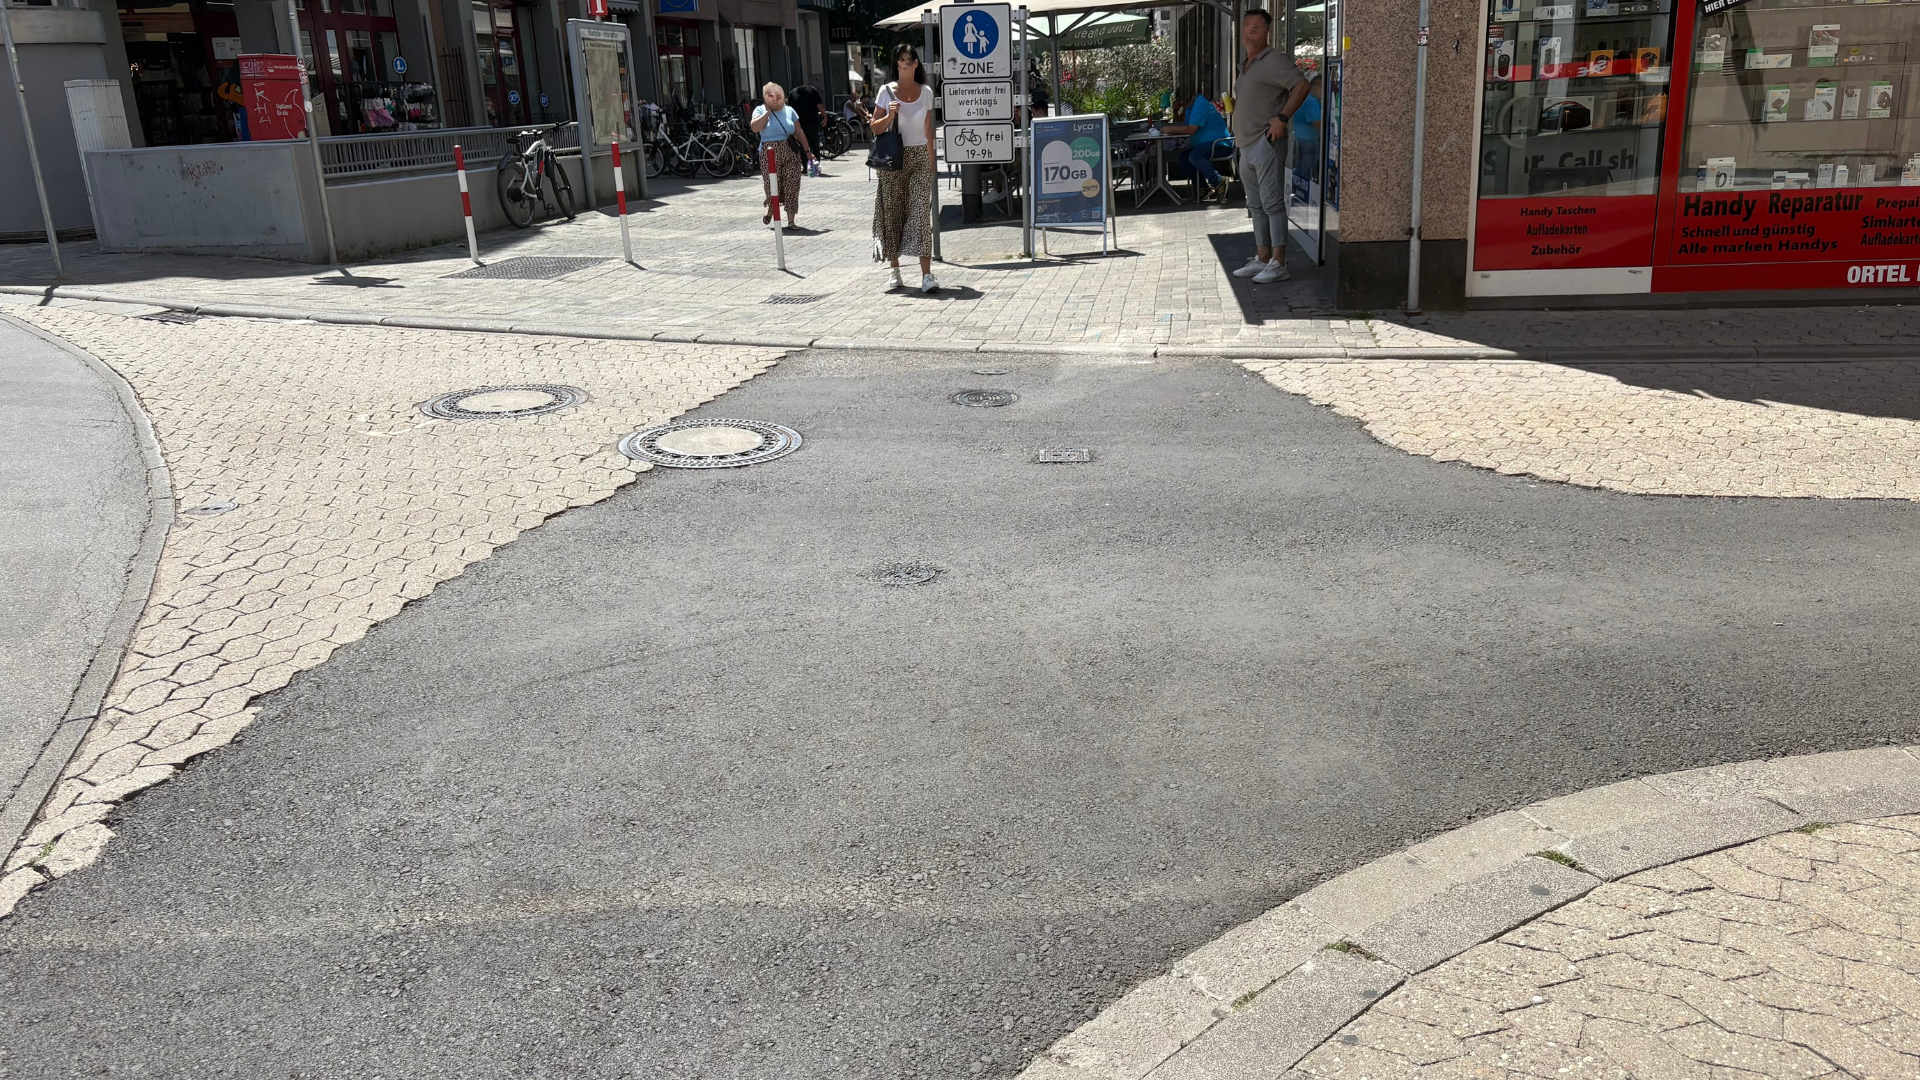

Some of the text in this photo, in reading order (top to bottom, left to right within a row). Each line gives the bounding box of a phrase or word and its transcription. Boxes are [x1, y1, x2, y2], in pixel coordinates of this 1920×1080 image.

[1704, 1, 1725, 13] HIER
[960, 61, 994, 74] ZONE
[949, 86, 1006, 96] Lieferverkehr frei
[958, 98, 998, 107] werktags
[1073, 123, 1094, 132] Lyca
[986, 132, 1004, 142] frei
[1520, 205, 1596, 218] Handy Taschen
[1683, 191, 1864, 222] Handy Reparatur
[1526, 223, 1588, 236] Aufladekarten
[1681, 222, 1816, 238] Schnell und günstig
[1531, 244, 1582, 256] Zubehör
[1678, 238, 1838, 254] Alle marken Handys
[1846, 264, 1911, 284] ORTEL
